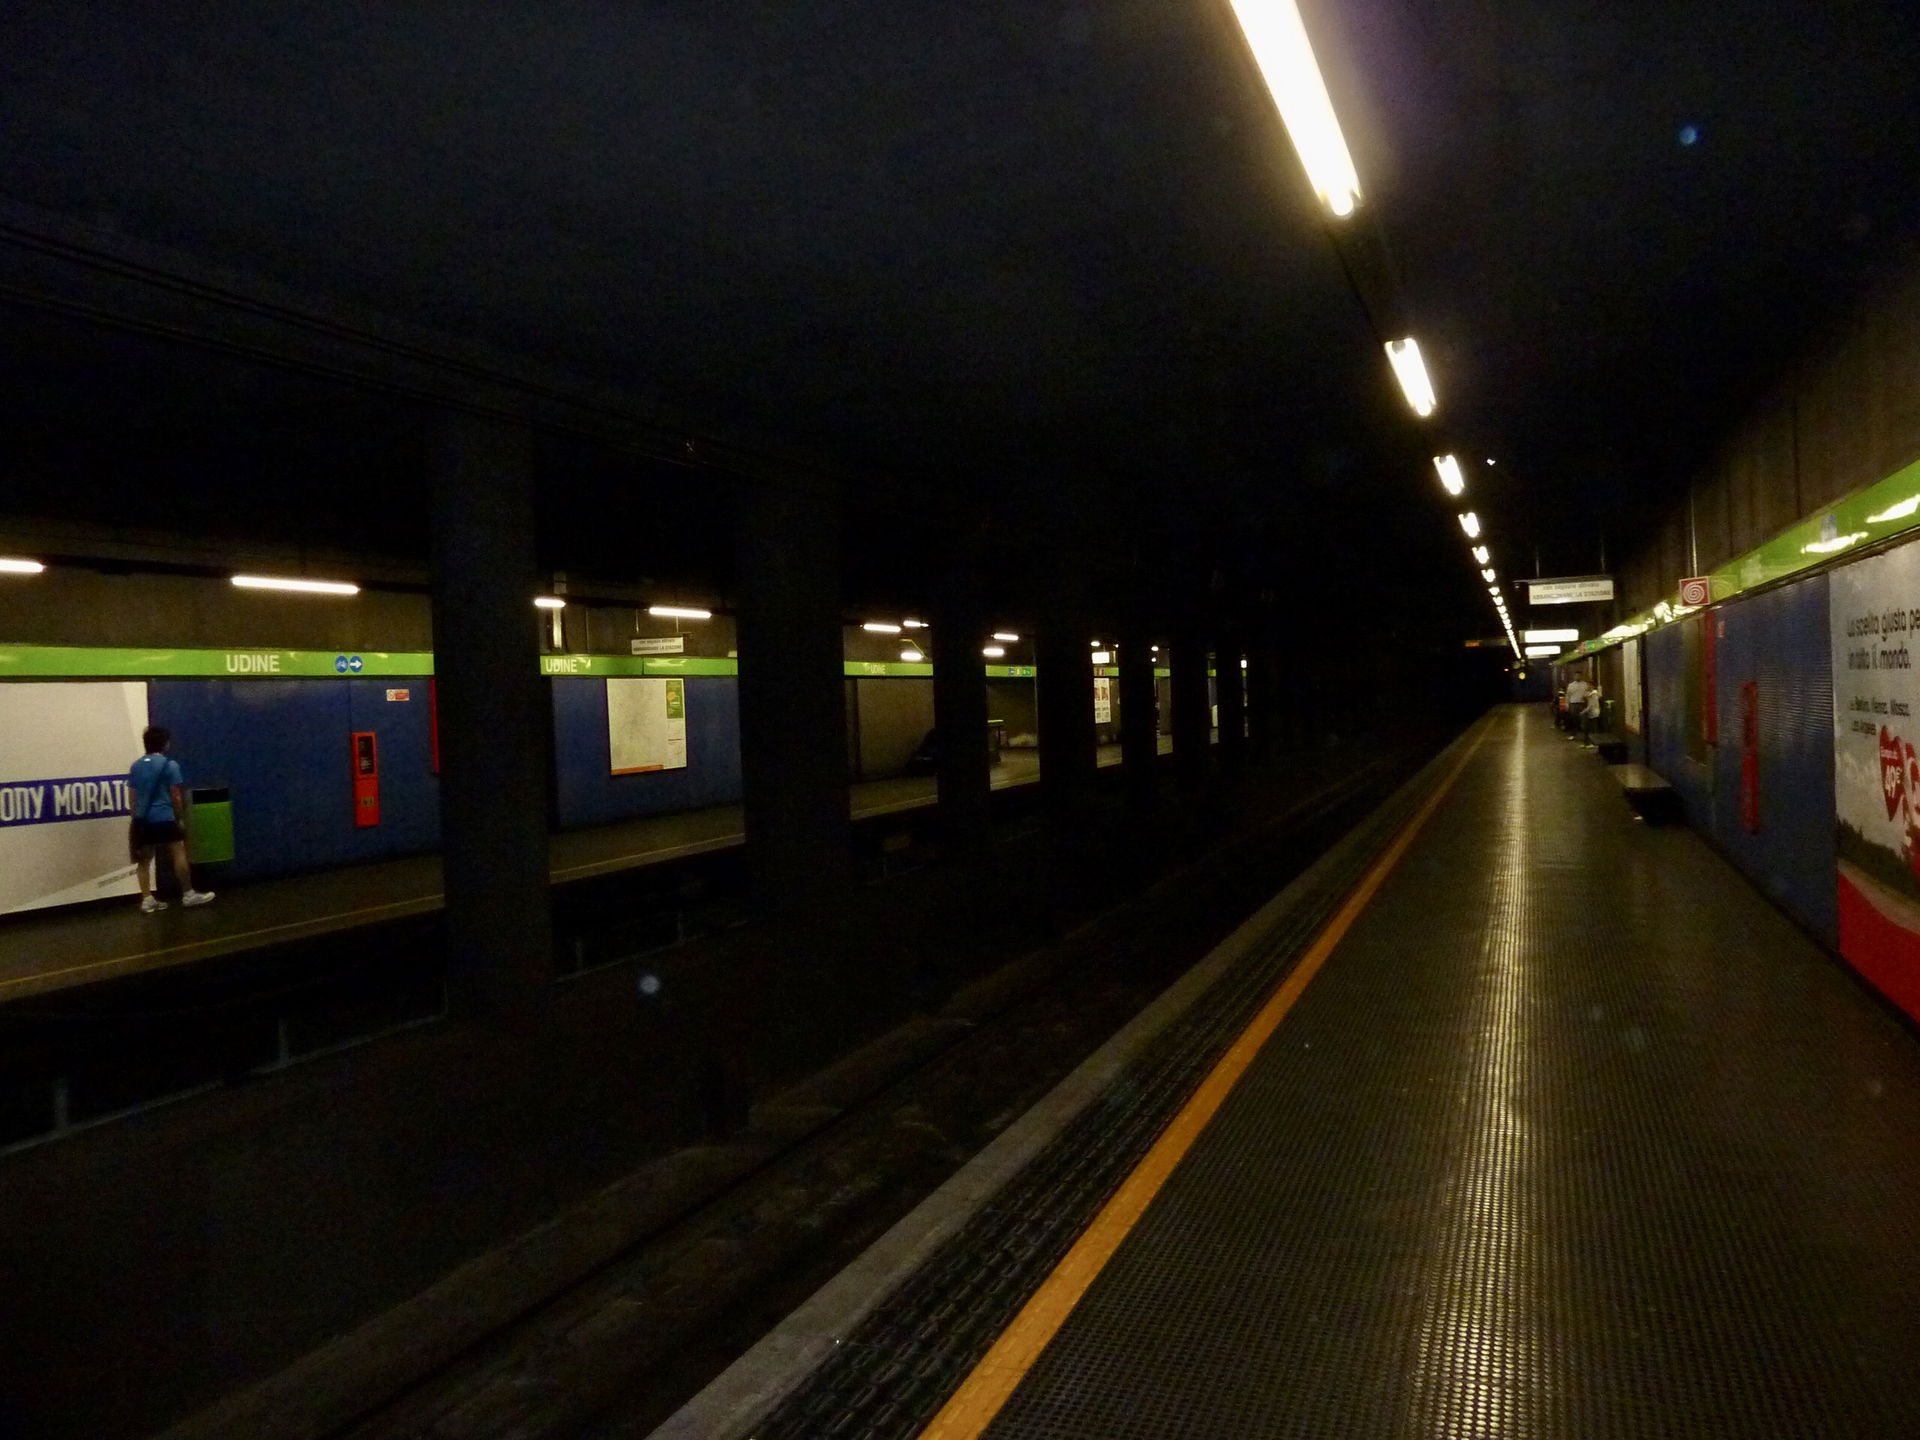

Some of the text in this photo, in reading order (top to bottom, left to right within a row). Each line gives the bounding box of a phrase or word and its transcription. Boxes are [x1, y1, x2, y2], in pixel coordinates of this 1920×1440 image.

[1881, 608, 1906, 641] giusta
[226, 654, 280, 673] UDINE
[545, 658, 578, 673] UDINE
